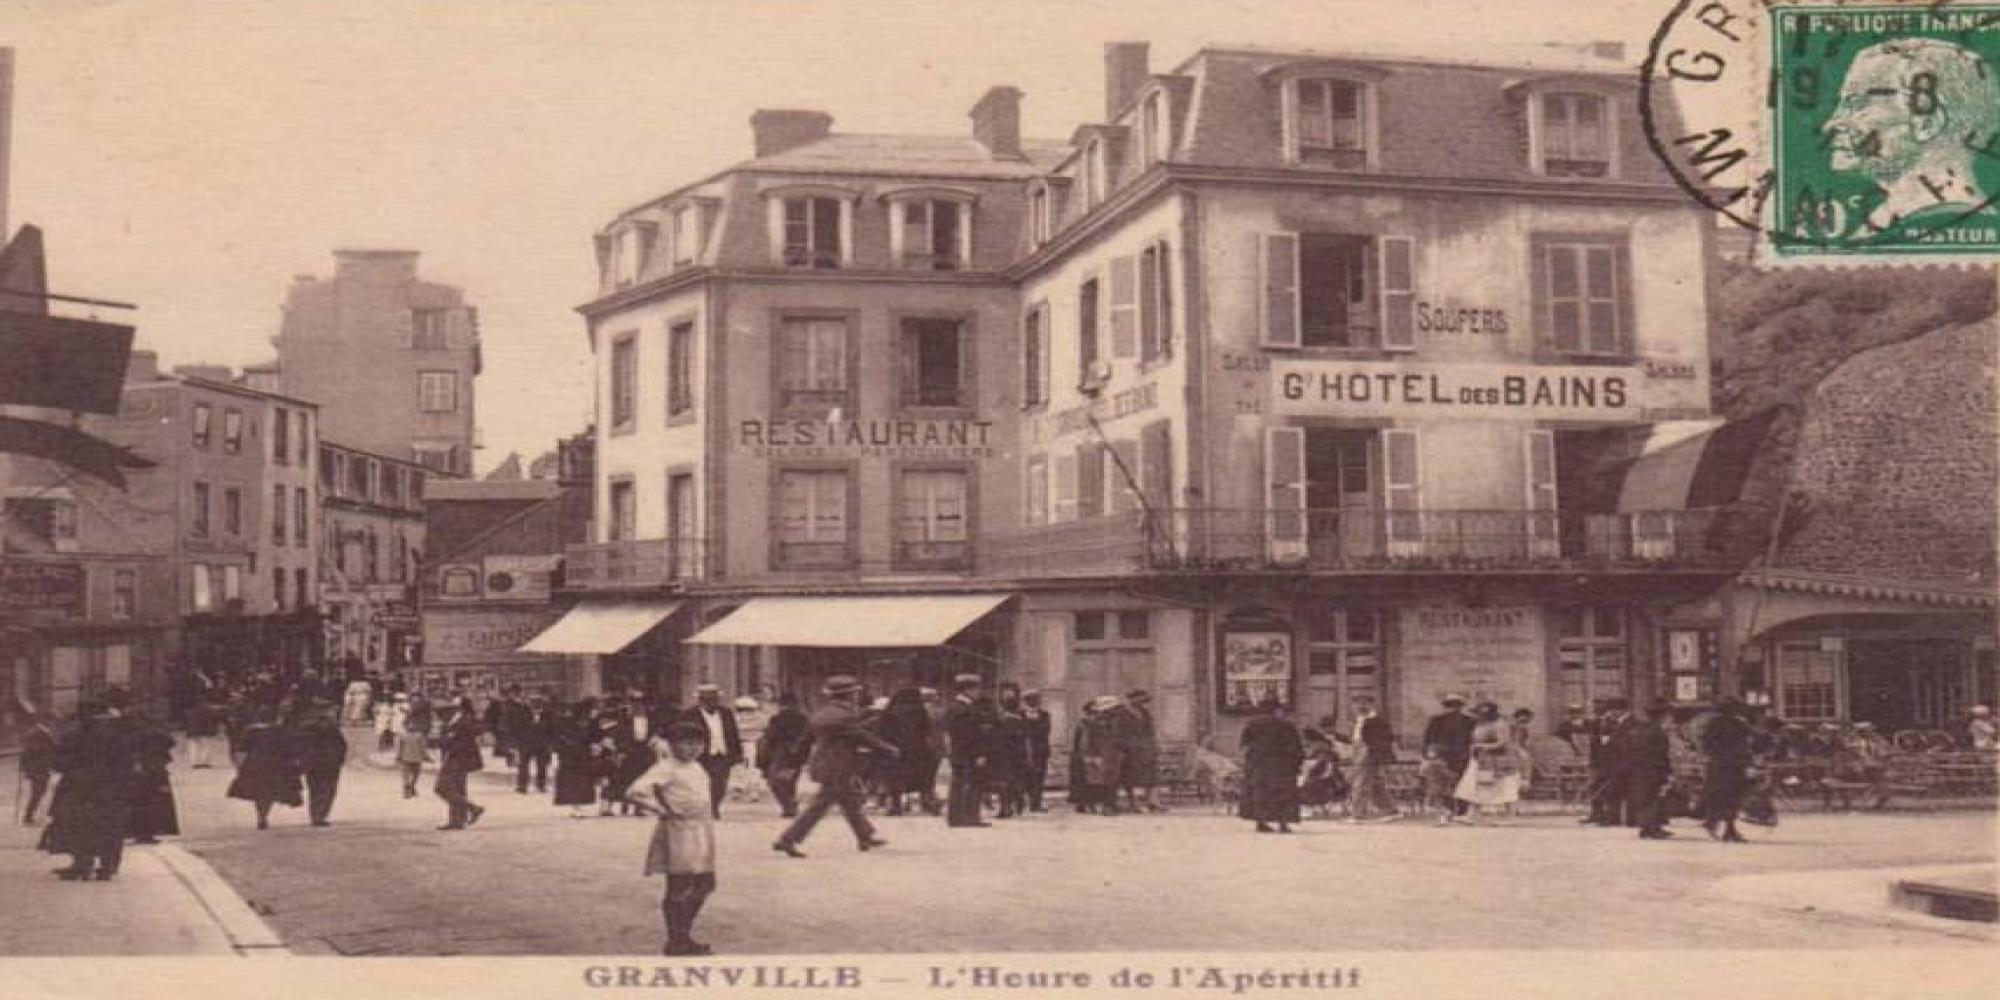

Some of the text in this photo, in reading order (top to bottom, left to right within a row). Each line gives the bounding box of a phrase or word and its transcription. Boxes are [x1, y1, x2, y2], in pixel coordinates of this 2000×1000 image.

[1321, 373, 1454, 404] HOTEL
[1503, 376, 1627, 408] BAINS
[740, 420, 993, 447] RESTAURANT
